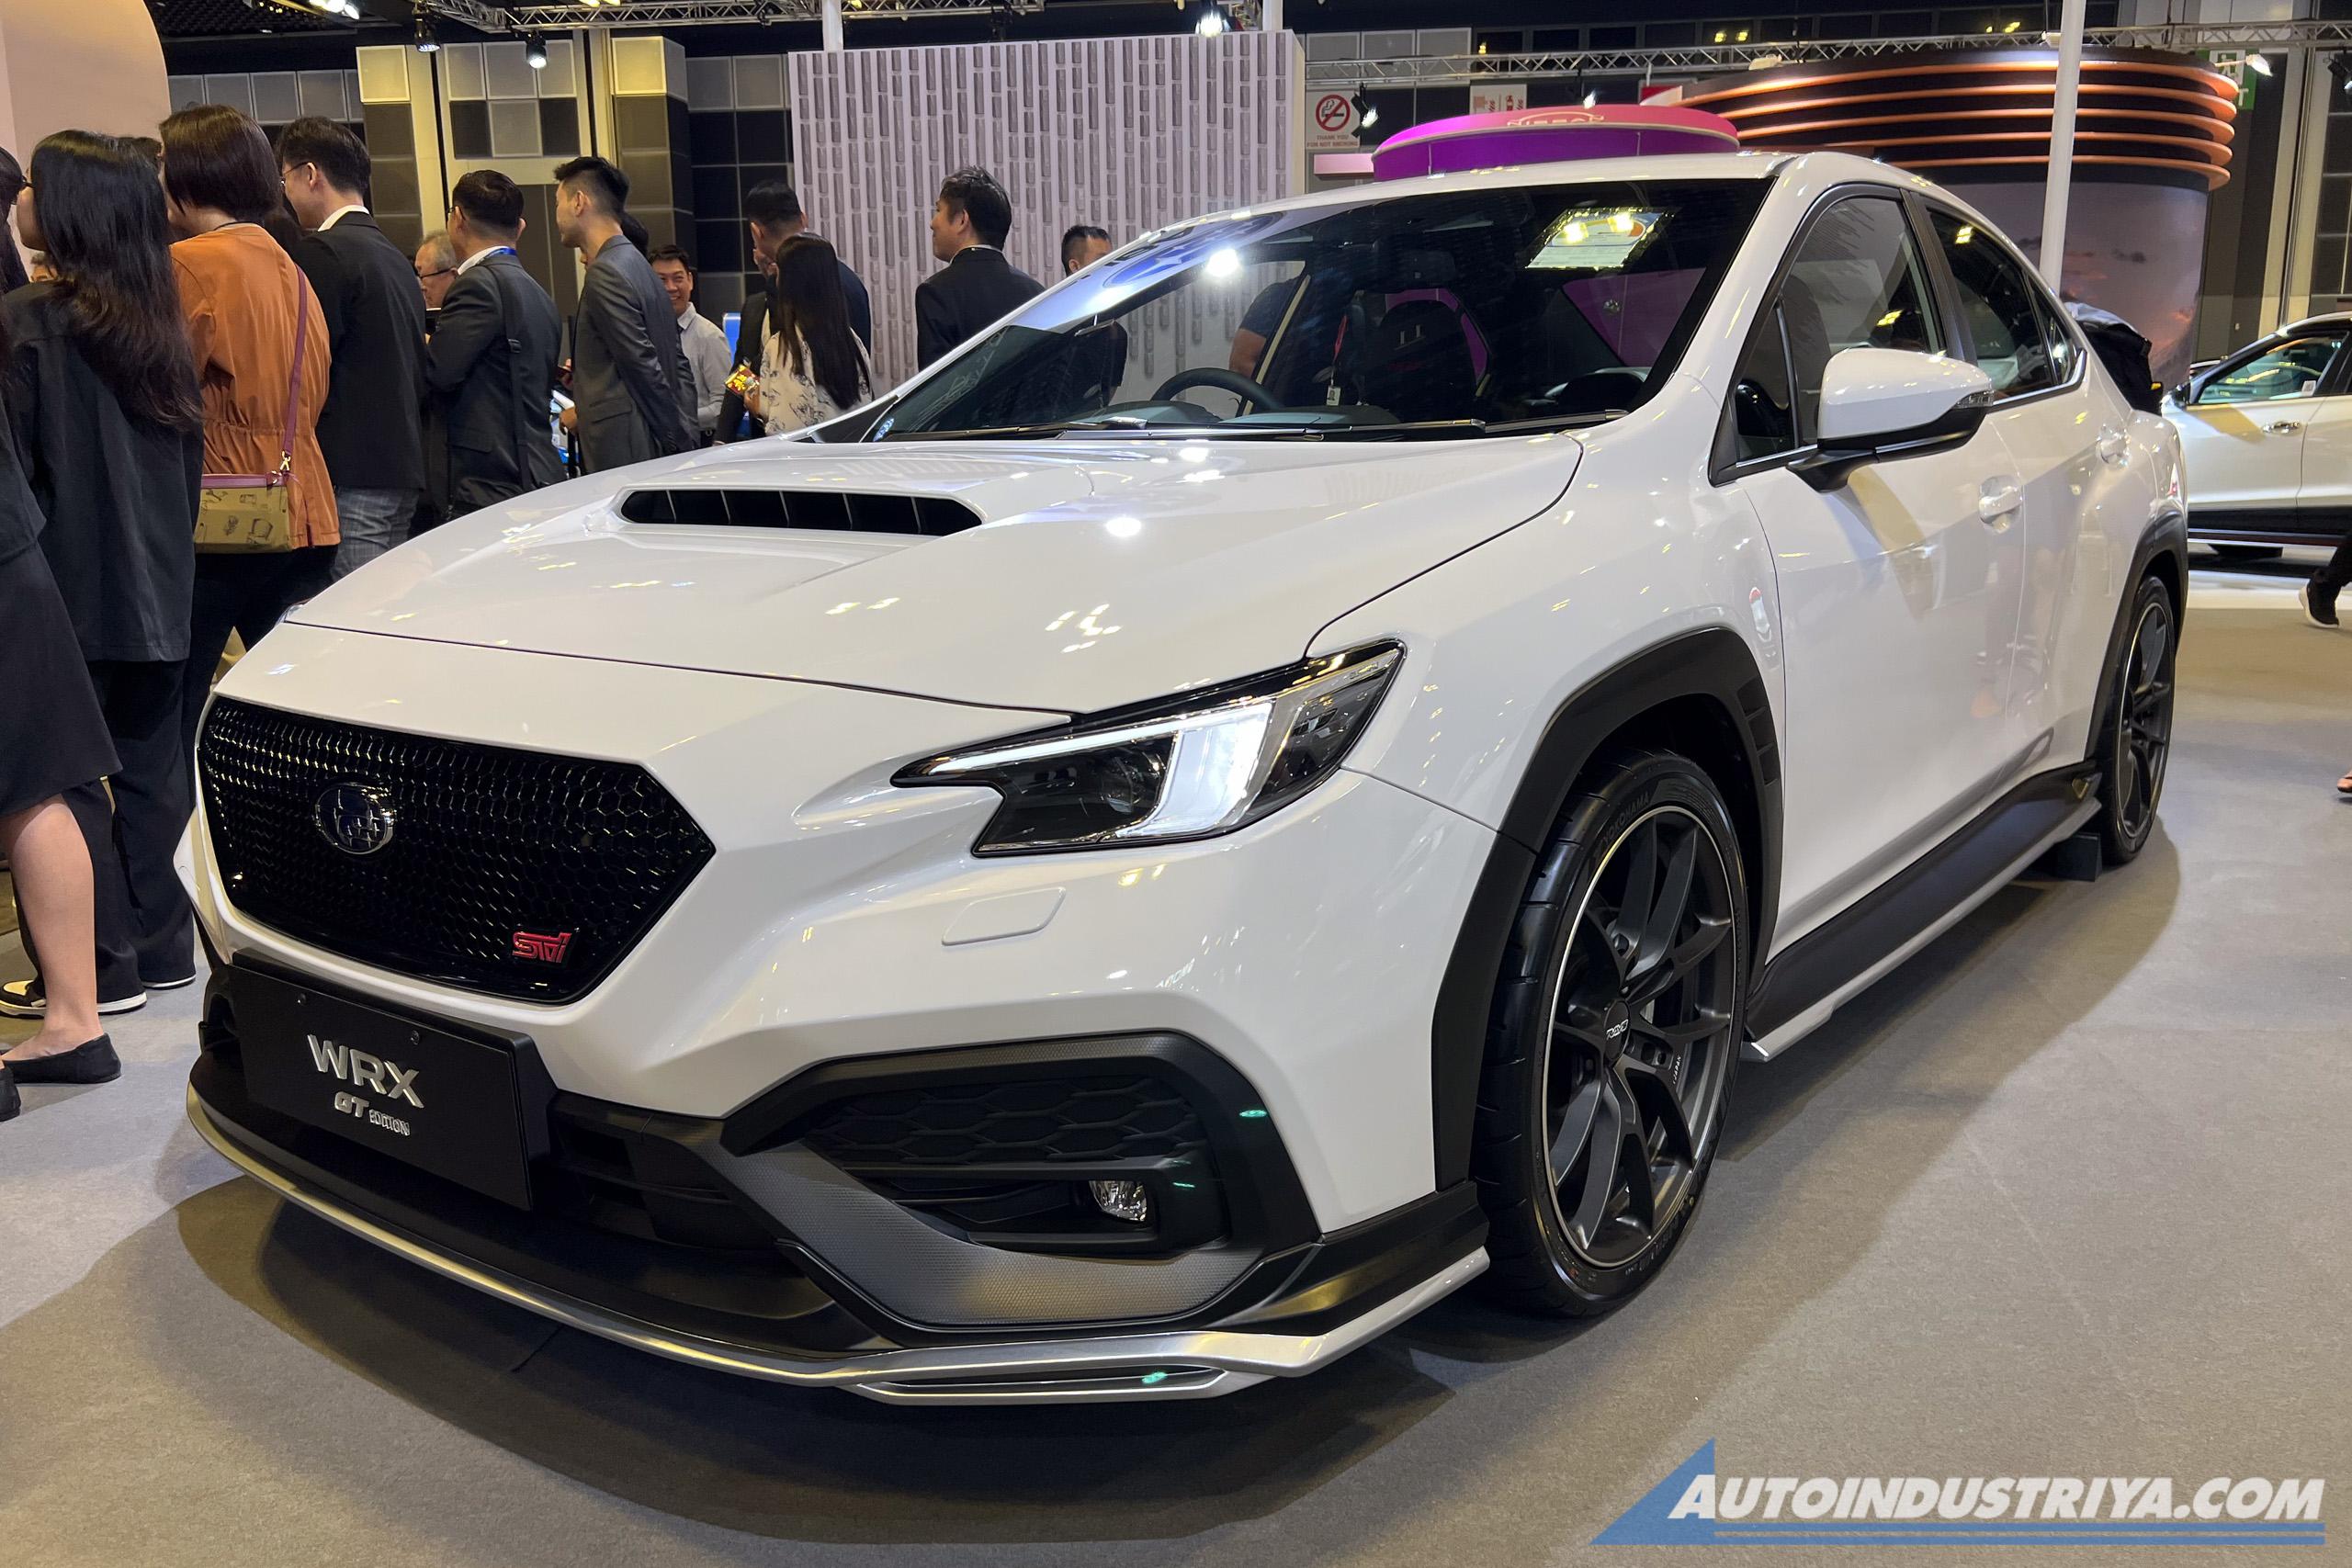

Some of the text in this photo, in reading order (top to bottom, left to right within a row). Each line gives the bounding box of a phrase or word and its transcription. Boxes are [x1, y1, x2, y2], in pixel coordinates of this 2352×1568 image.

[307, 1033, 424, 1109] WRX
[334, 1091, 411, 1136] GT EDITION
